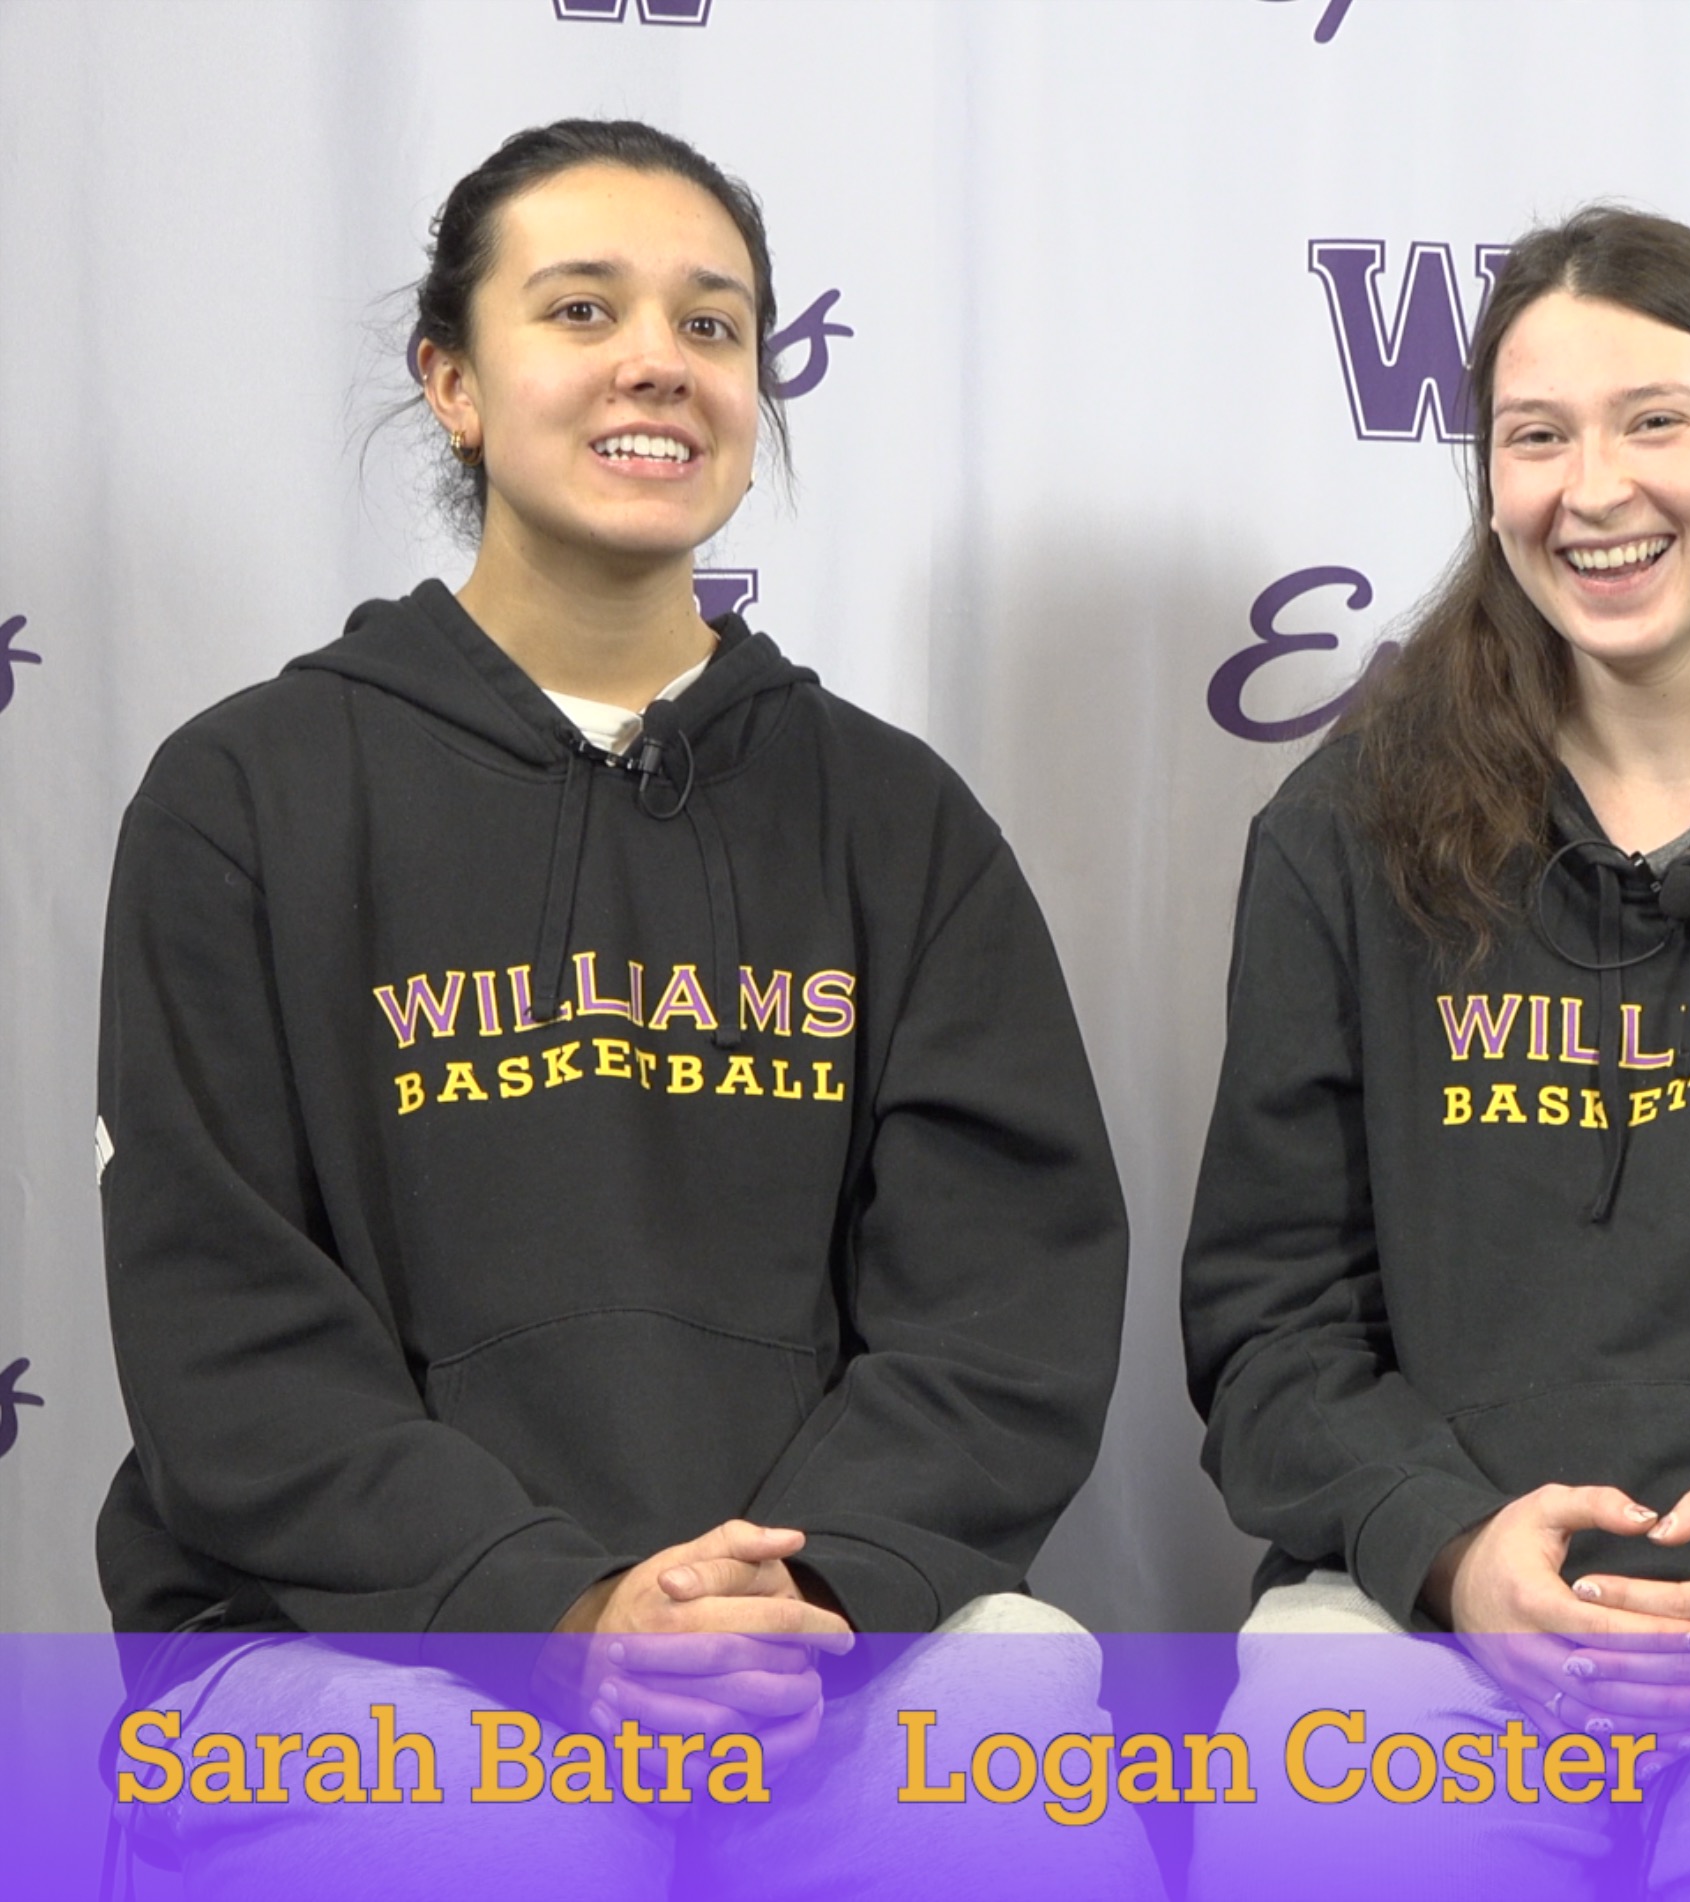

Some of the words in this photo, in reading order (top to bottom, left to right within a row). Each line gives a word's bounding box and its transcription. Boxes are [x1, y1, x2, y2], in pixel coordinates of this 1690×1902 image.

[1308, 238, 1513, 443] W
[372, 950, 857, 1049] WILLIAMS
[393, 1037, 846, 1115] BASKETBALL
